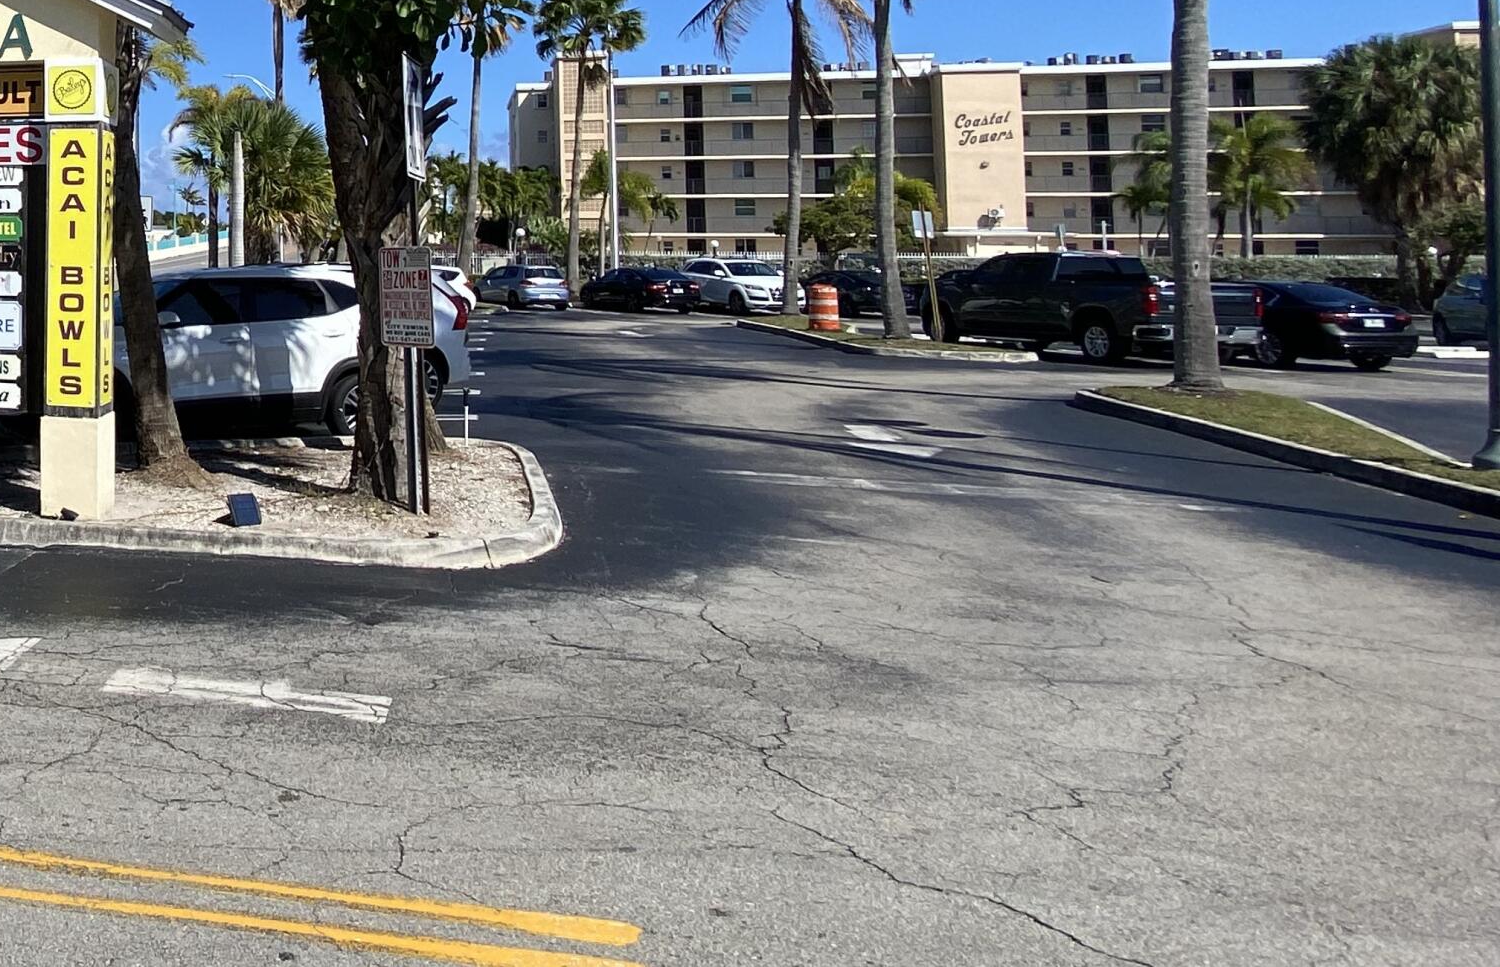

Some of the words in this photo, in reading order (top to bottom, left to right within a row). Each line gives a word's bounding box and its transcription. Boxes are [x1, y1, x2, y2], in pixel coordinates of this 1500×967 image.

[954, 110, 1011, 129] Coastal
[958, 130, 1014, 146] Towers
[60, 140, 86, 239] ACAI
[382, 251, 400, 268] TOW
[393, 270, 417, 289] ZONE
[58, 266, 85, 395] BOWLS
